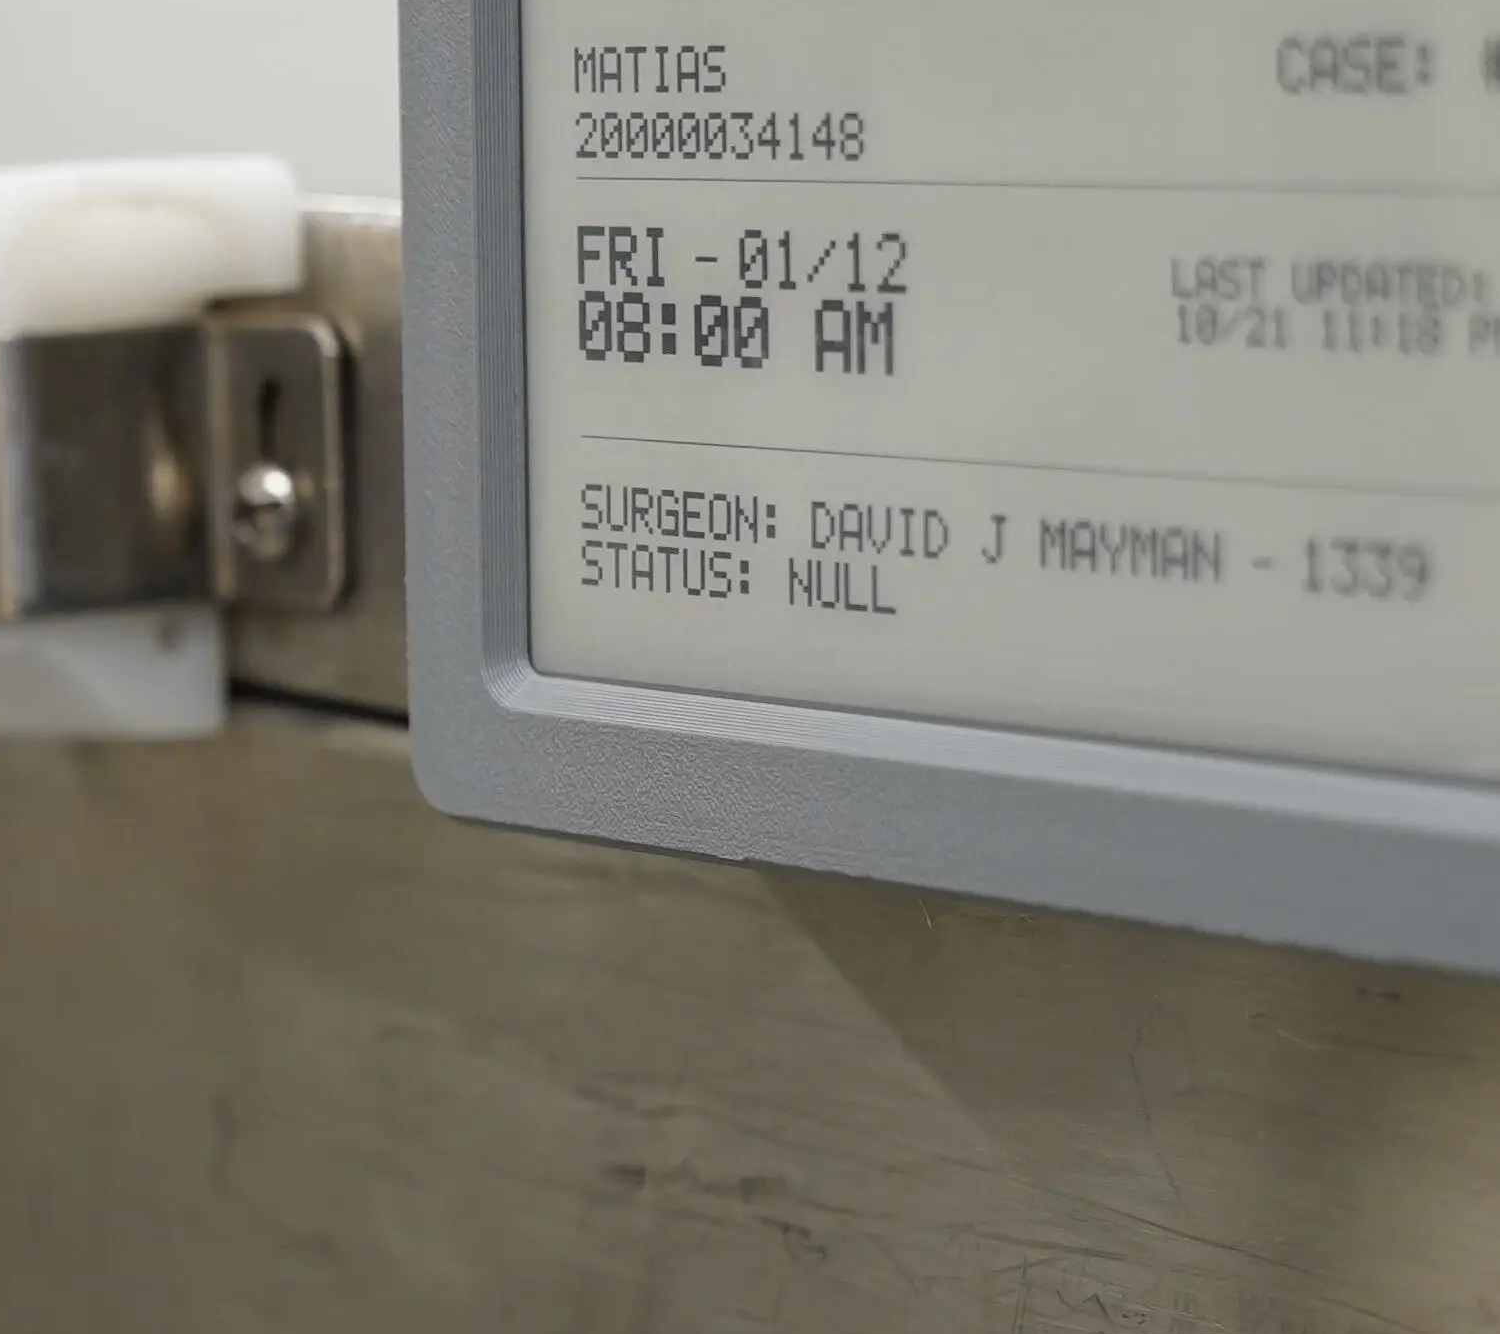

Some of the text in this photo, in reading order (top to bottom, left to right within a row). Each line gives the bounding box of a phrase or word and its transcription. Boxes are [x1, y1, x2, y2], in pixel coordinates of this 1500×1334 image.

[573, 45, 726, 94] MATIAS
[1274, 31, 1434, 95] CASE:
[574, 111, 865, 161] 20000034148
[576, 225, 665, 286] FRI
[738, 229, 908, 293] 01/12
[1169, 256, 1492, 309] LAST UPDATED:
[577, 290, 895, 376] 08:00 AM
[580, 483, 777, 544] SURGEON:
[810, 500, 950, 559] DAVID
[980, 514, 1008, 564] J
[1038, 517, 1223, 585] MAYMAN
[1300, 535, 1434, 604] 1339
[580, 539, 897, 615] STATUS: NULL
